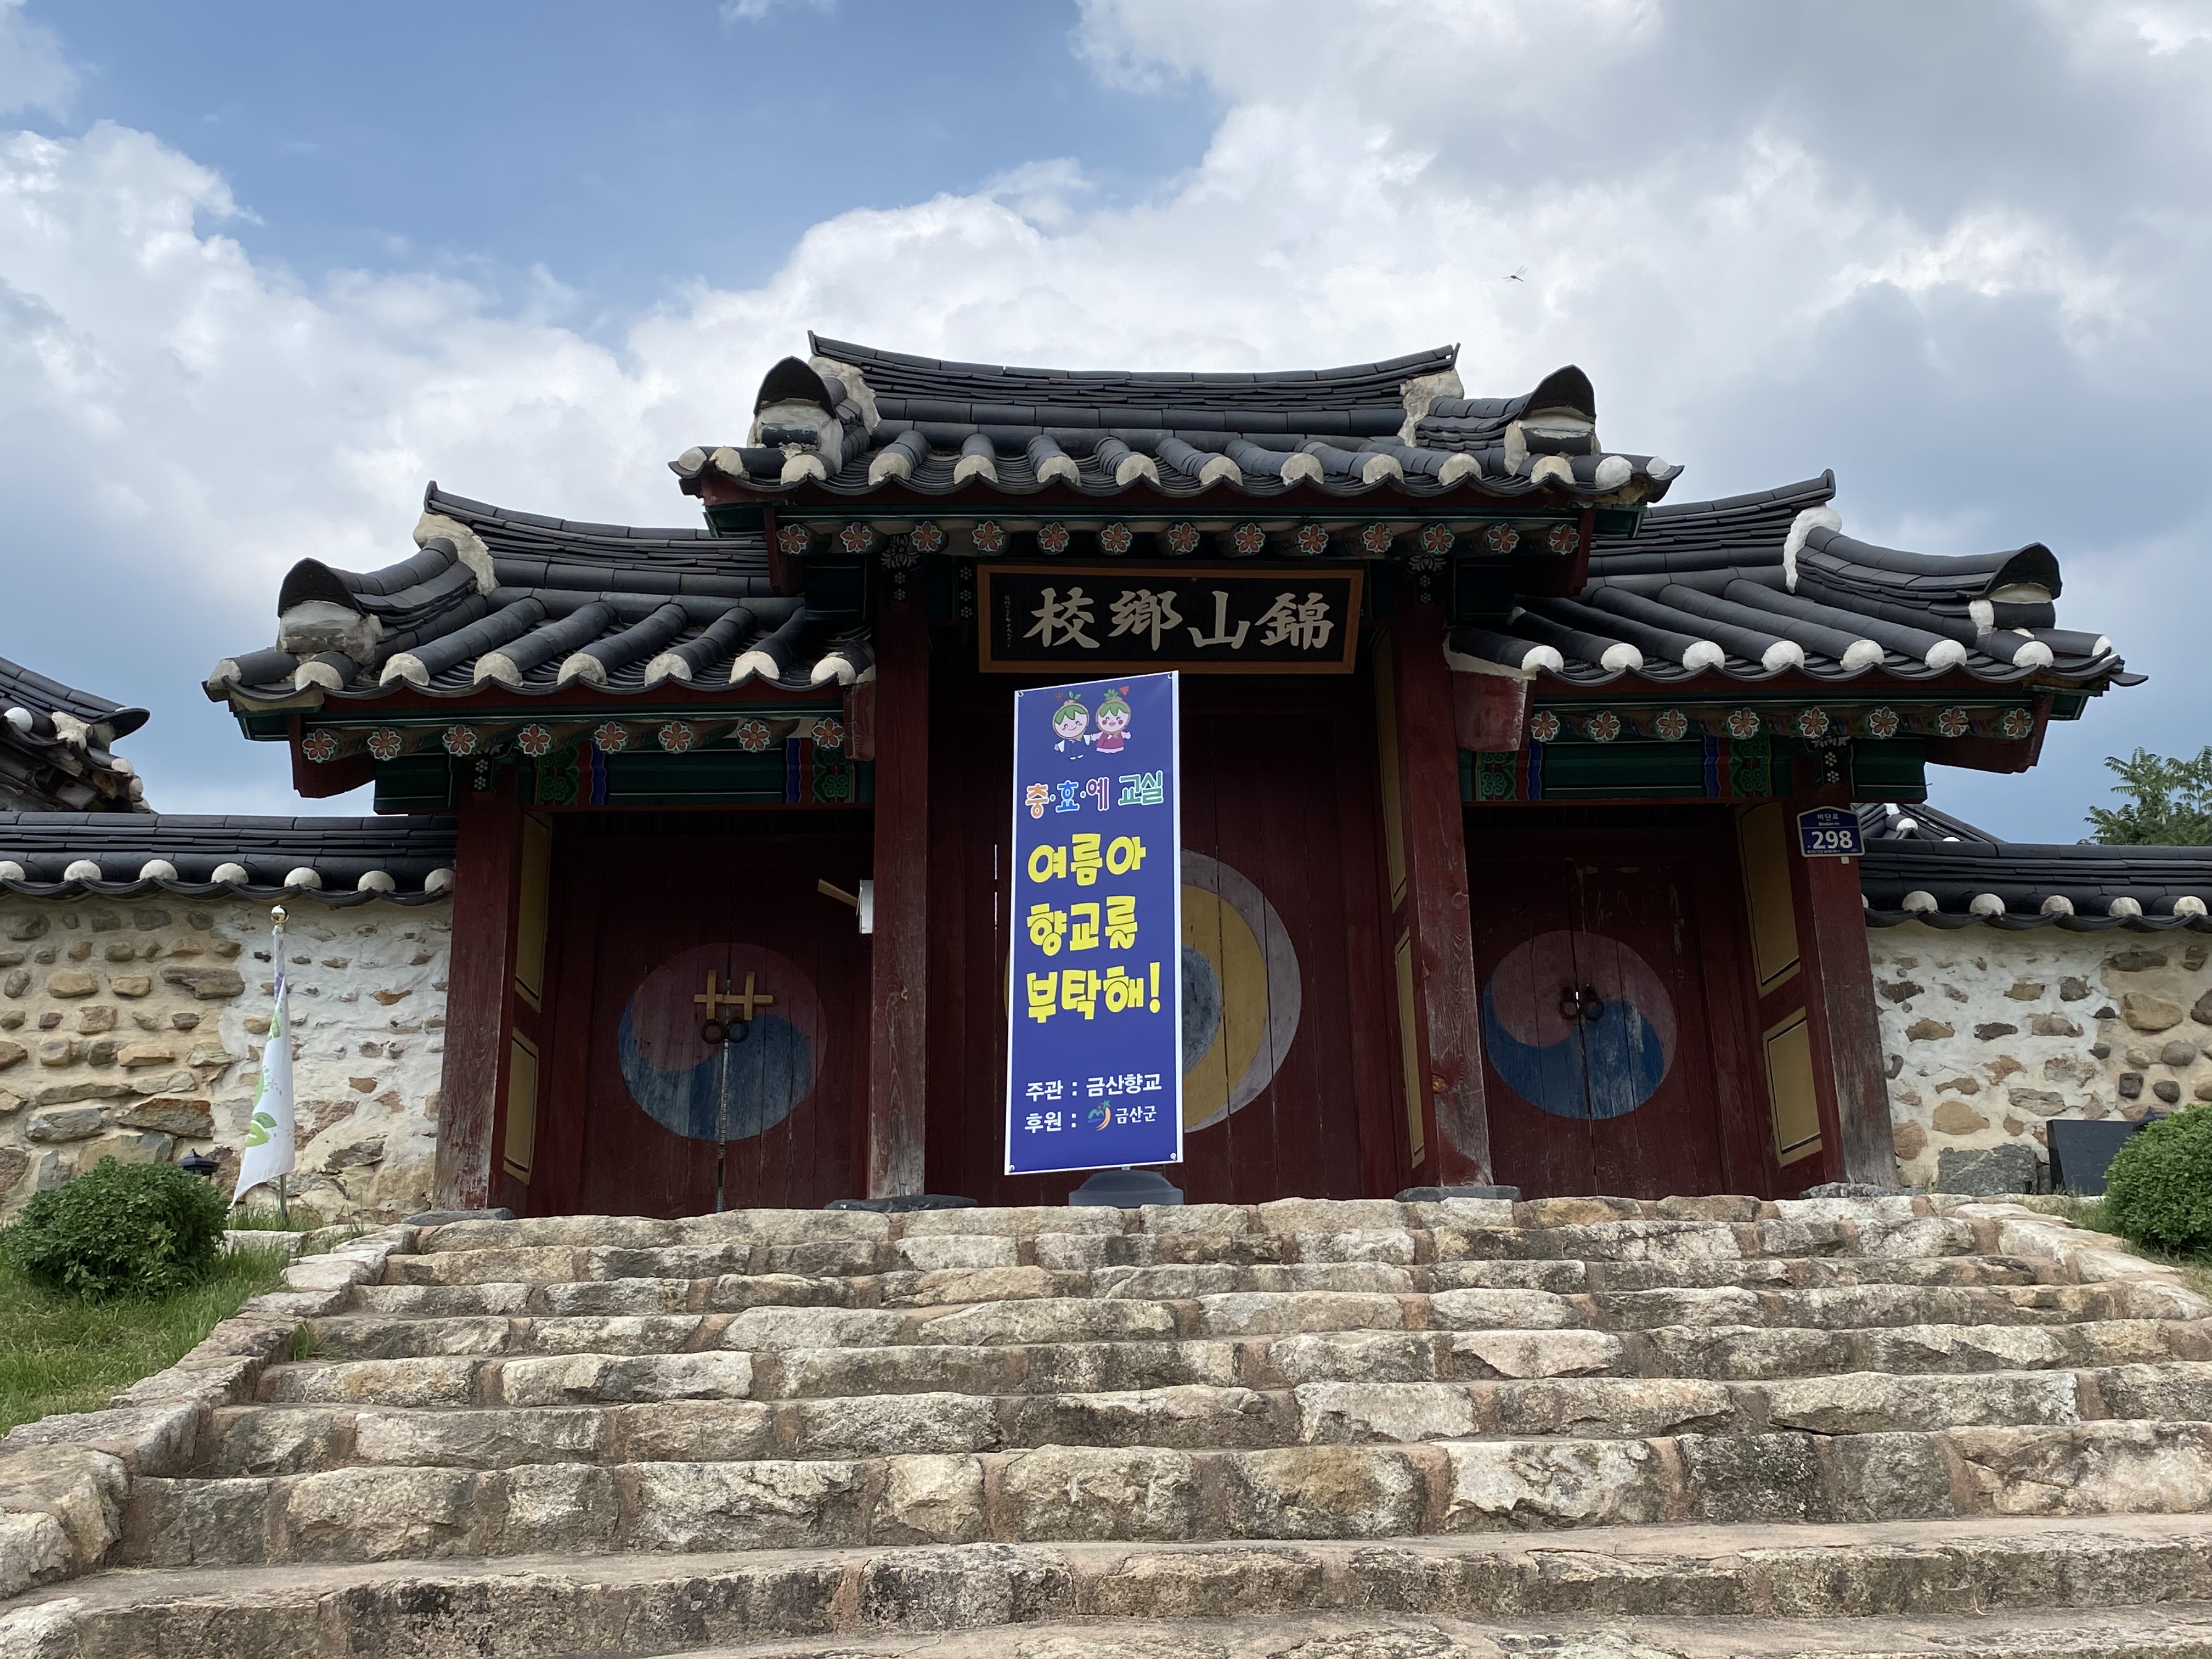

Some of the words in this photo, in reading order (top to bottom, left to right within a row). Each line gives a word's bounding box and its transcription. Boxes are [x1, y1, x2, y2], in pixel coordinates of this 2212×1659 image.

[1118, 770, 1164, 806] 교실
[1812, 830, 1853, 849] 298
[1028, 833, 1146, 886] 여름아
[1026, 895, 1138, 956] 향교를
[1026, 962, 1161, 1023] 부탁해!
[1025, 1080, 1064, 1102] 주관
[1086, 1073, 1162, 1097] 금산향교
[1024, 1111, 1062, 1133] 후원
[1115, 1105, 1157, 1125] 금산군
